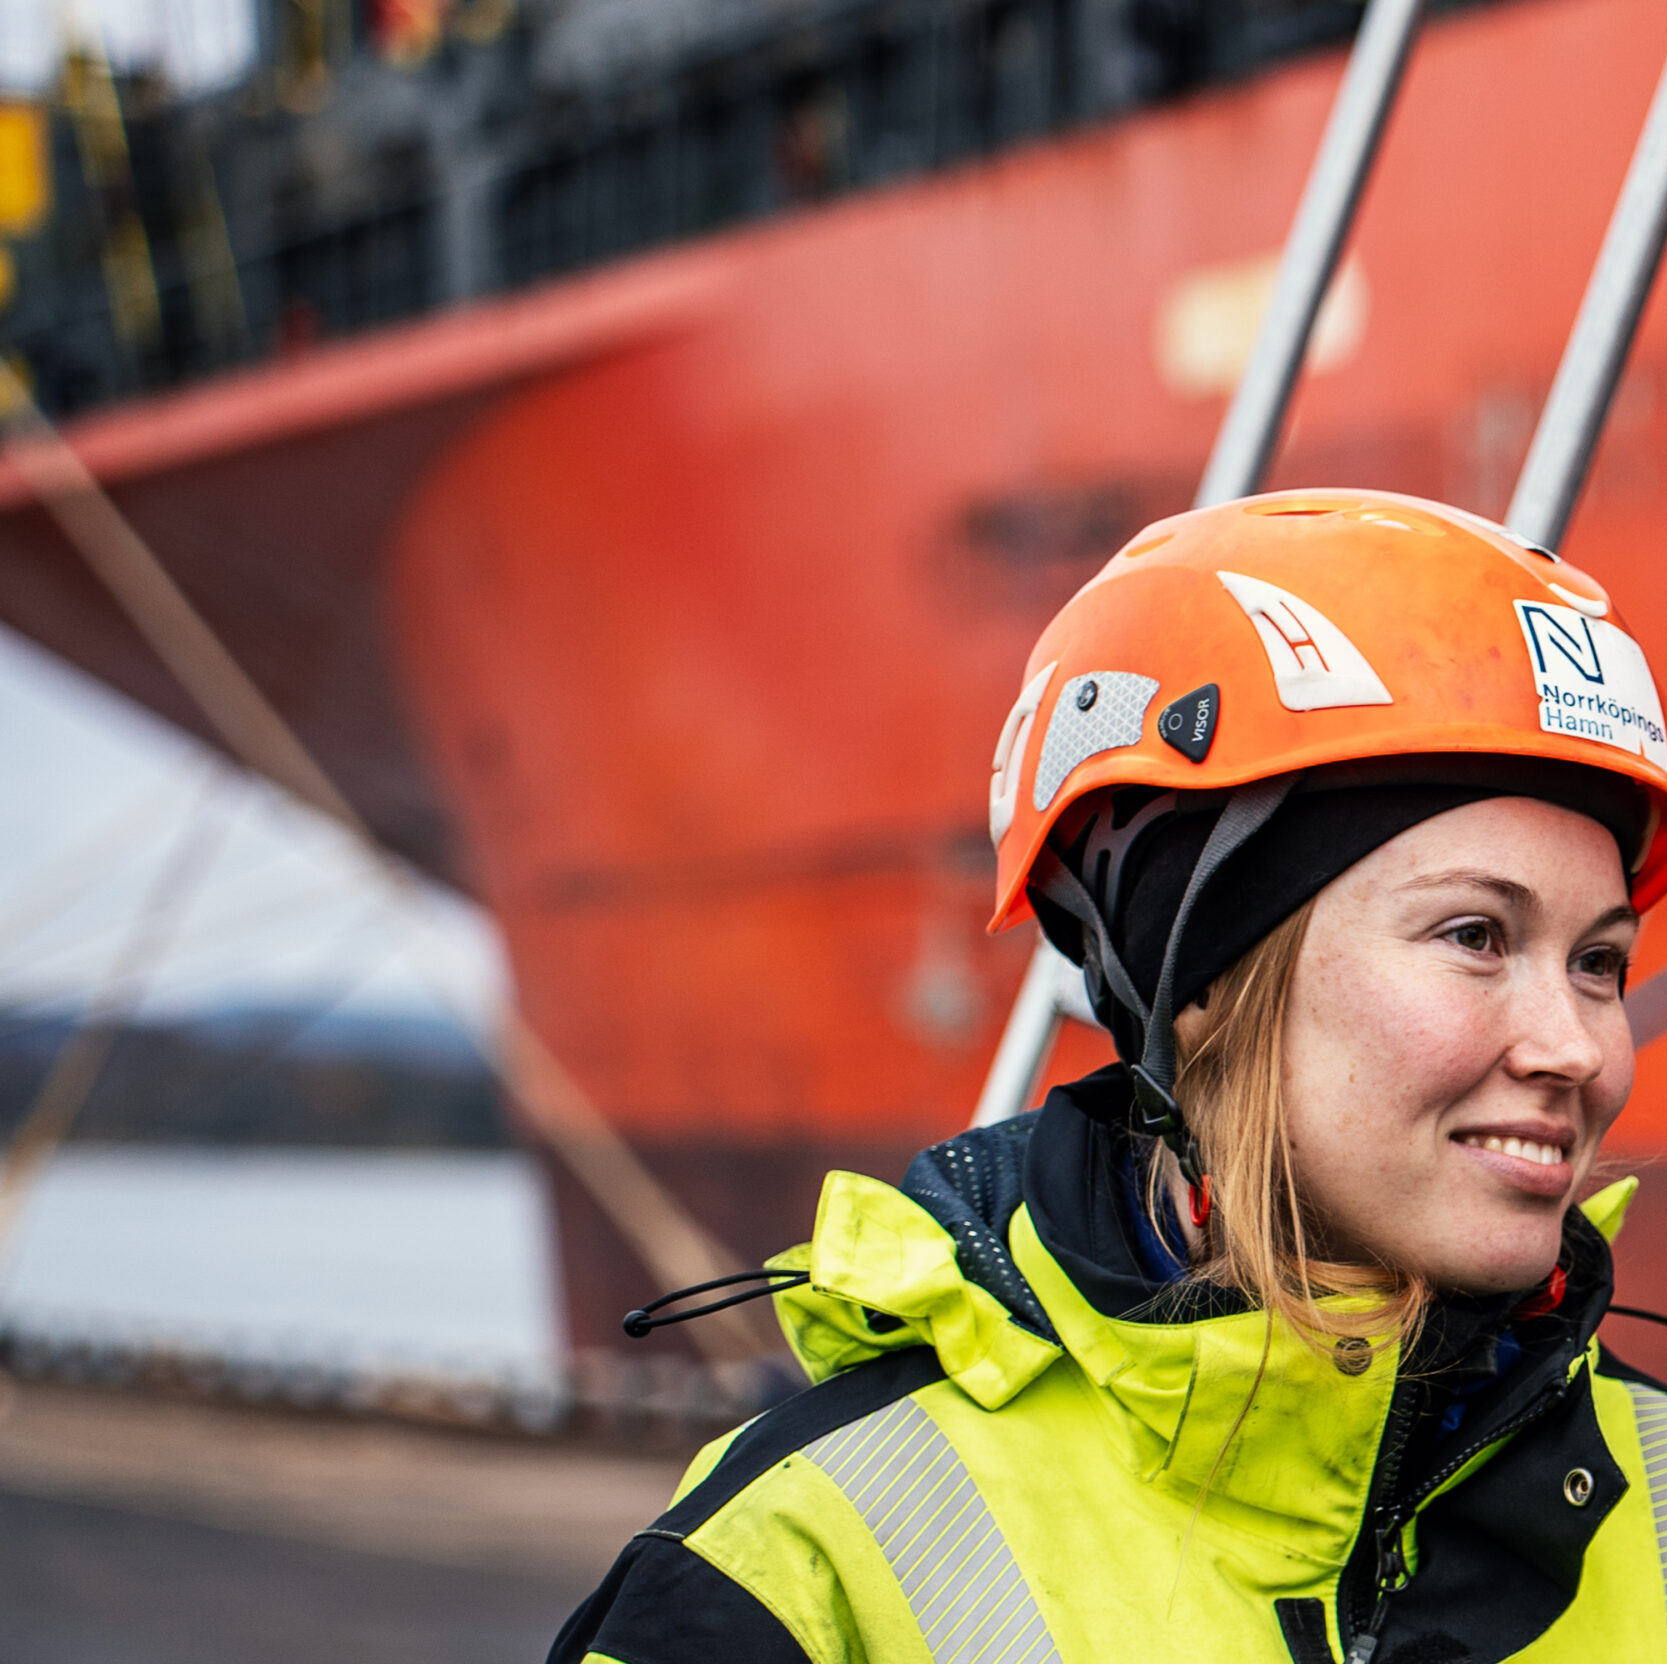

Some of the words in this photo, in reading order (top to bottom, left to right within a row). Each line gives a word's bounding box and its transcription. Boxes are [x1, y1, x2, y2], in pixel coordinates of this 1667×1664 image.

[1191, 698, 1210, 742] VISOR
[1542, 683, 1665, 743] Norrköpings
[1546, 706, 1614, 740] Hamn
